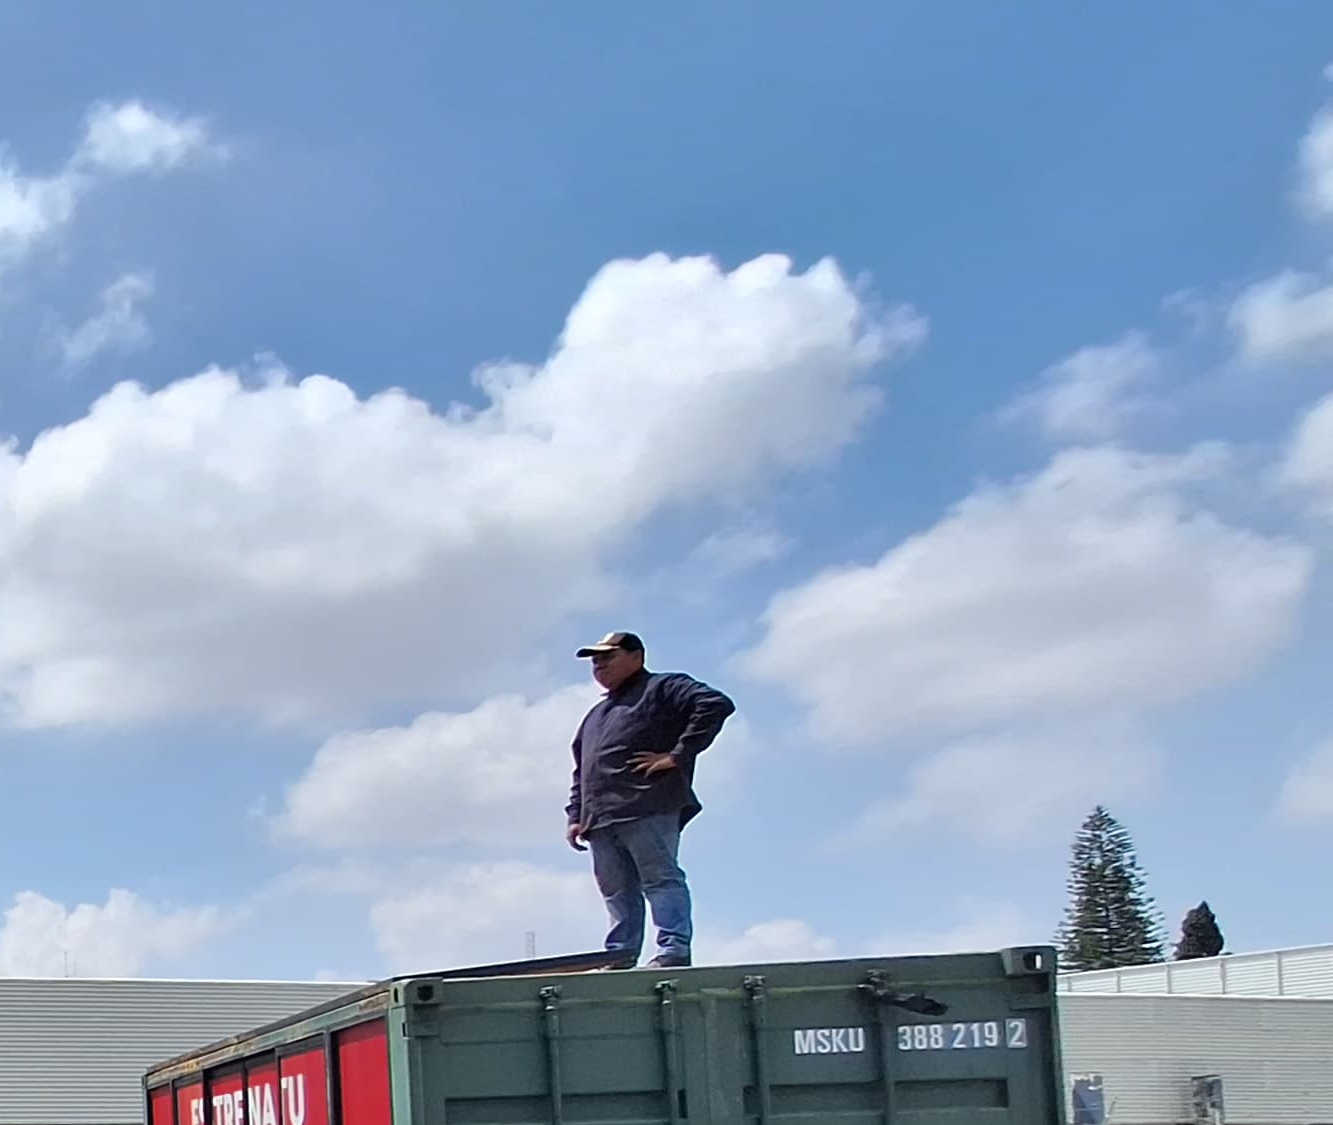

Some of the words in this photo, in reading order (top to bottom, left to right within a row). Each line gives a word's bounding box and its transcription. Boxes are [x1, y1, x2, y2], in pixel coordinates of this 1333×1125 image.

[794, 1027, 864, 1053] MSKU
[898, 1024, 943, 1049] 388
[952, 1021, 999, 1047] 219
[1008, 1019, 1026, 1047] 2
